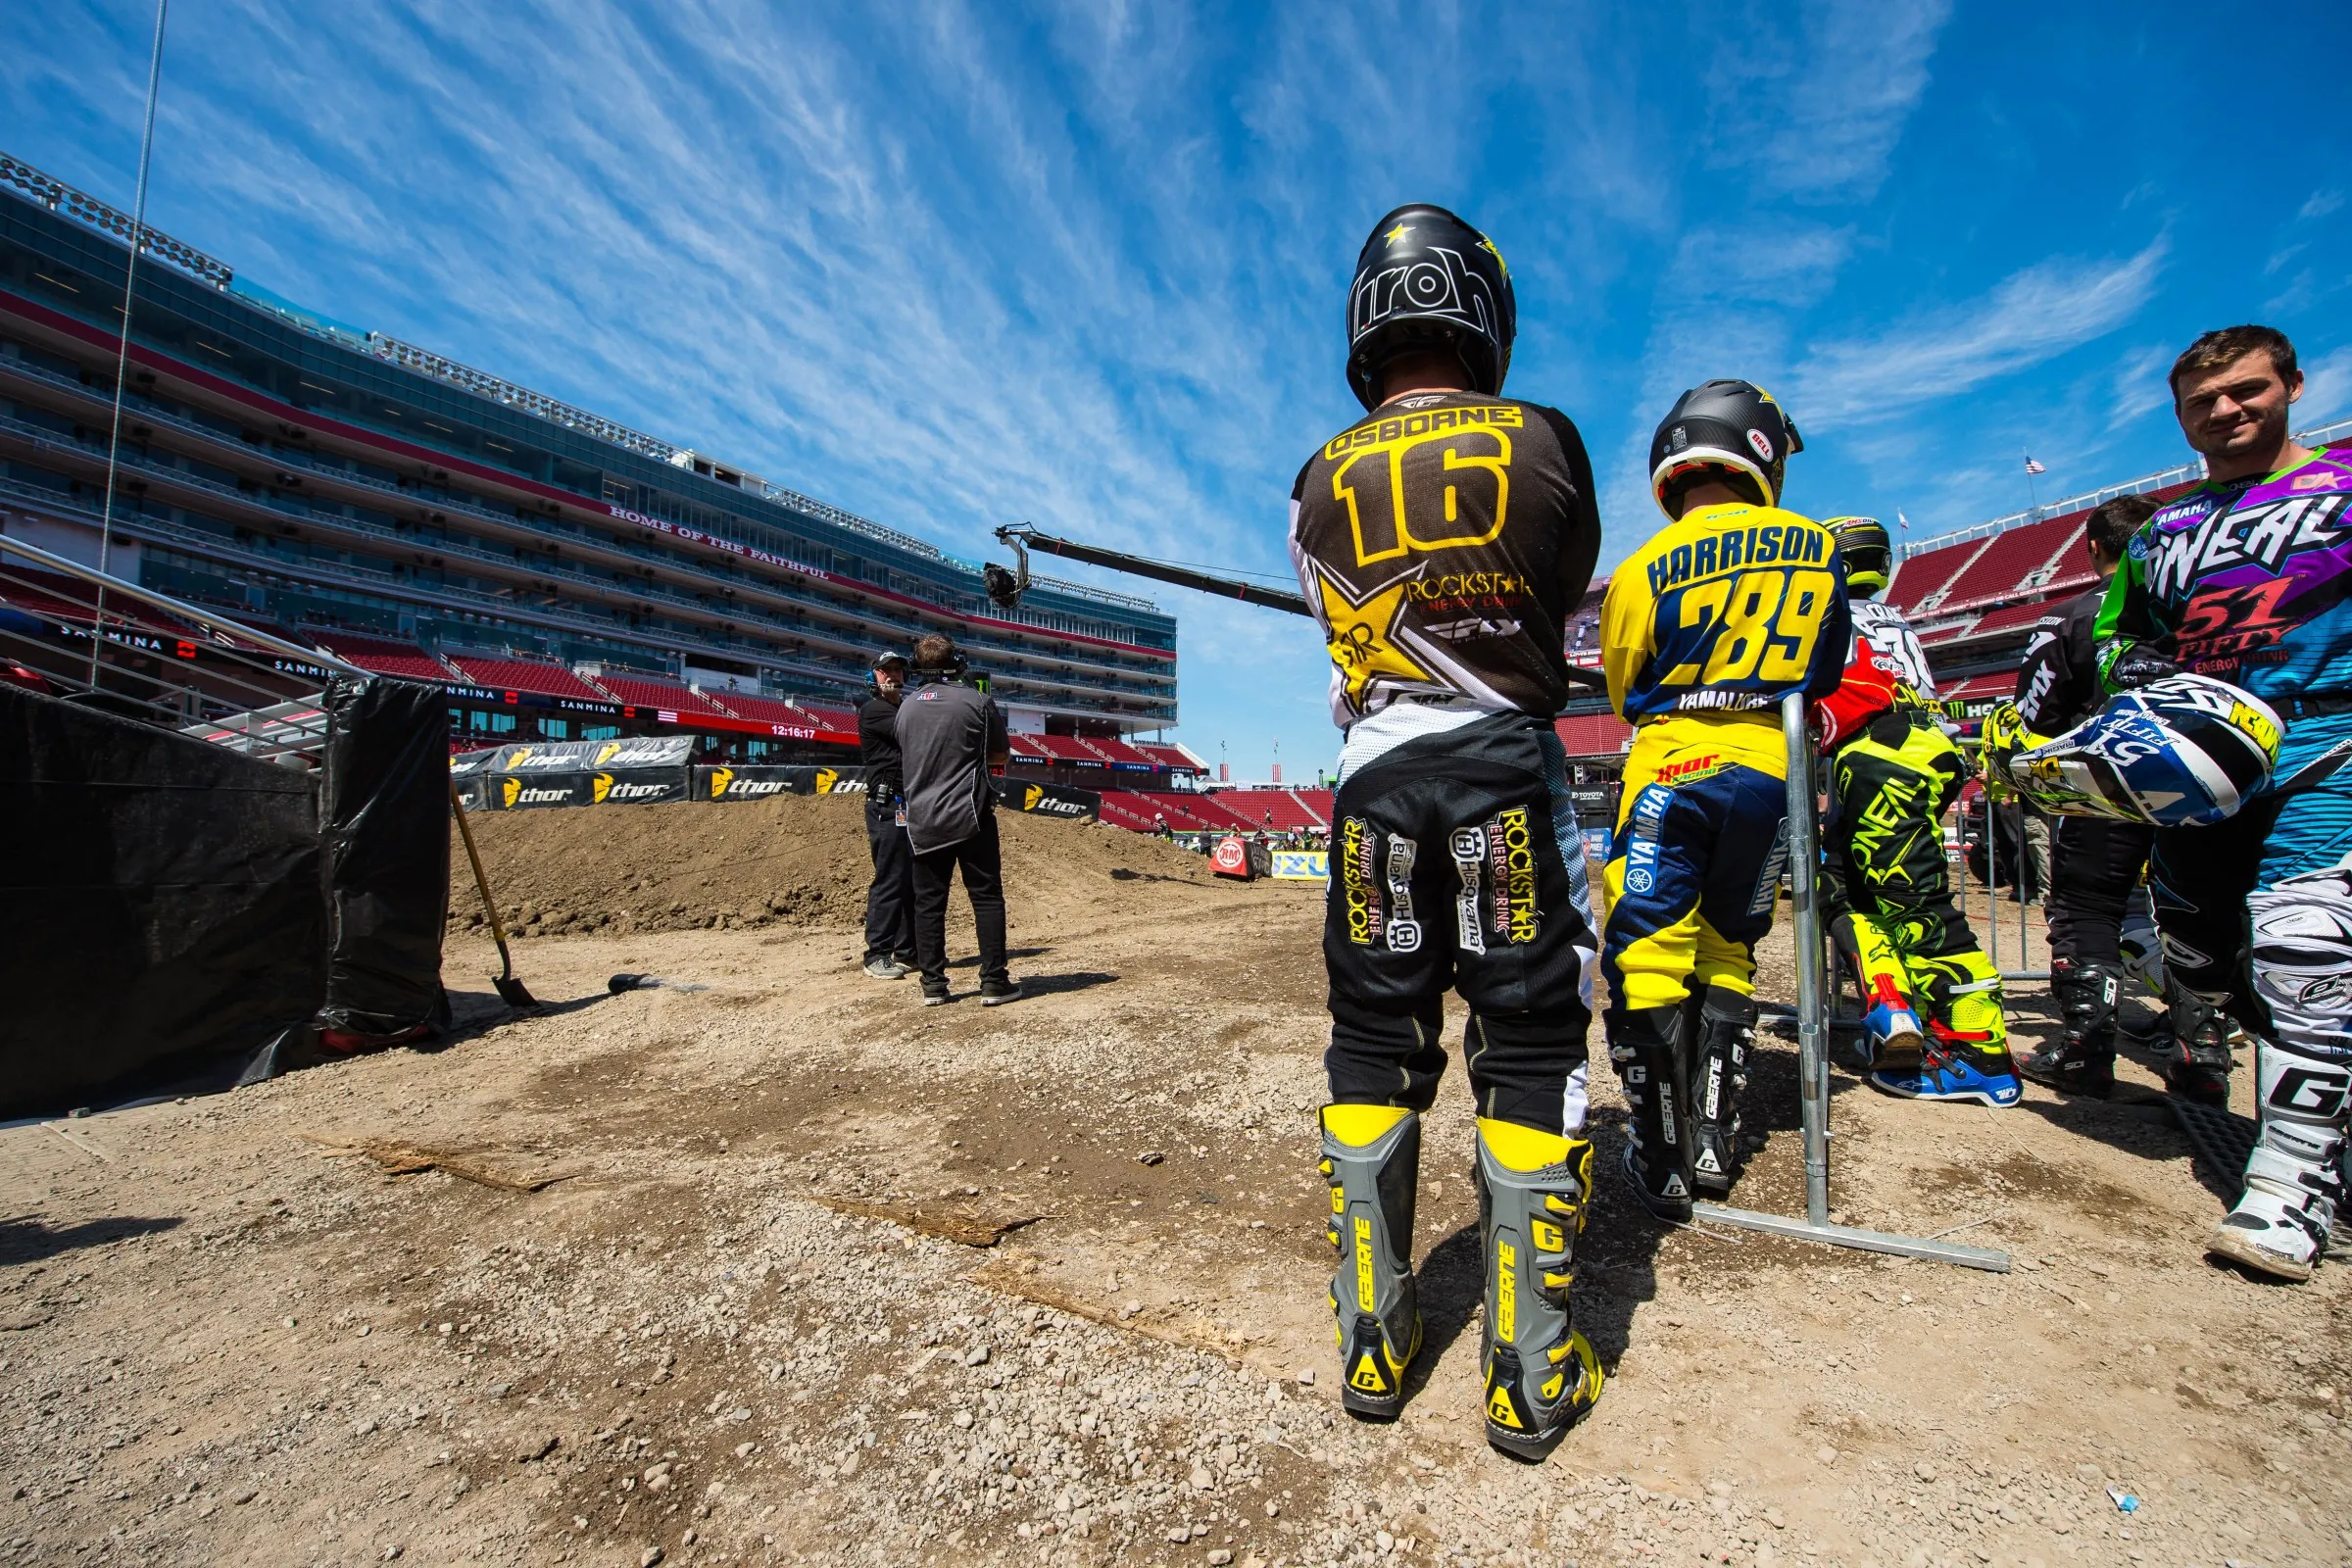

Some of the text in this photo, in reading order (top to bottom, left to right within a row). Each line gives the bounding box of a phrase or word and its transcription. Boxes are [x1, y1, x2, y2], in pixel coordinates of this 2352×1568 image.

[1329, 407, 1520, 455] OSBORNE
[1750, 431, 1771, 460] BELL
[1333, 427, 1512, 568] 16
[610, 506, 829, 580] HOME OF THE FAITHFUL
[1646, 526, 1824, 599] HARRISON
[2176, 576, 2294, 641] 51
[1659, 570, 1836, 685] 289
[274, 661, 336, 680] SANMIN
[2195, 657, 2239, 674] ENERGY
[446, 686, 494, 700] NMINA
[561, 700, 616, 714] SANMINA
[771, 725, 815, 739] 12:16:17
[520, 753, 579, 768] thor
[518, 787, 573, 804] thor
[610, 782, 670, 798] thor
[728, 778, 792, 794] thor
[1038, 797, 1087, 814] thor
[1629, 786, 1670, 865] YAMAHA
[1360, 836, 1372, 879] DRINK
[1490, 825, 1510, 930] ENERGY DRINK
[1460, 860, 1480, 948] Husqvarna
[2102, 976, 2118, 1006] SIDI
[2063, 1059, 2084, 1071] SIDI
[2269, 1067, 2350, 1117] G
[1356, 1372, 1376, 1388] G
[1491, 1403, 1510, 1422] G
